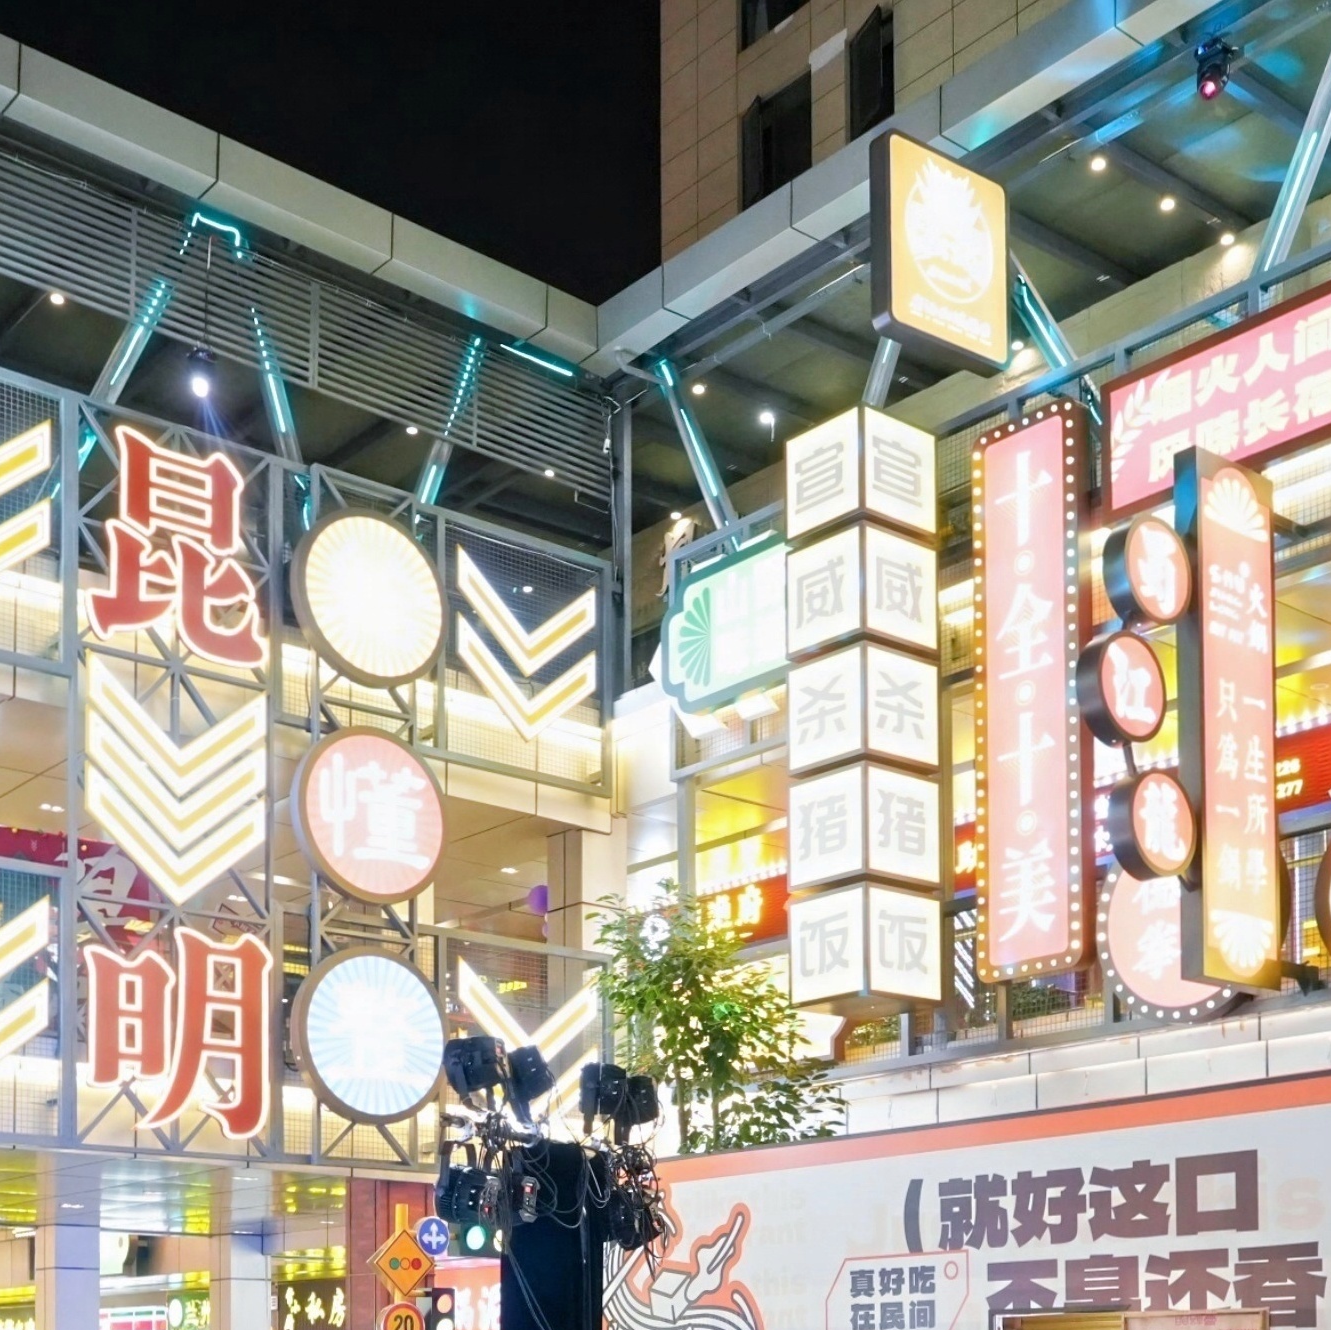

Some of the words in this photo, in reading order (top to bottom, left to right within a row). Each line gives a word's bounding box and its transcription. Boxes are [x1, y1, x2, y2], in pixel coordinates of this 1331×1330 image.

[83, 424, 270, 668] 昆
[794, 444, 852, 978] 宣威杀猪饭
[872, 434, 929, 976] 宣威杀猪饭
[83, 928, 273, 1141] 明
[850, 1266, 936, 1298] 真好吃
